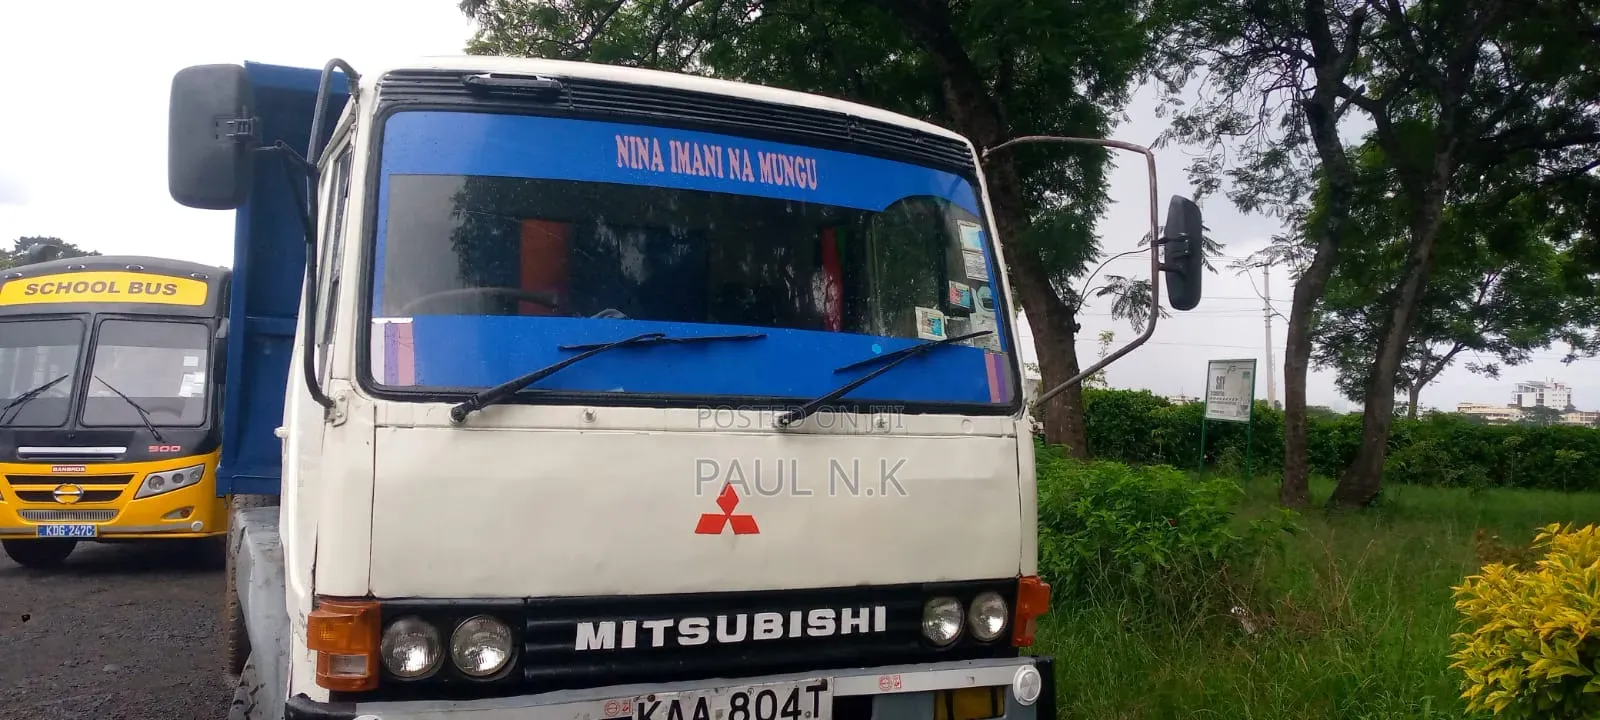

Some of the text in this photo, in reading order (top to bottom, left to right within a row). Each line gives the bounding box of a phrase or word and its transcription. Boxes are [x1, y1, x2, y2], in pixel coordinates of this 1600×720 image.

[615, 134, 818, 190] NINA IMANI NA MUNGU
[24, 281, 178, 296] SCHOOL BUS
[46, 526, 94, 536] KDG 247C
[575, 605, 887, 651] MITSUBISHI
[636, 696, 712, 720] KAA
[728, 682, 828, 720] 804T
